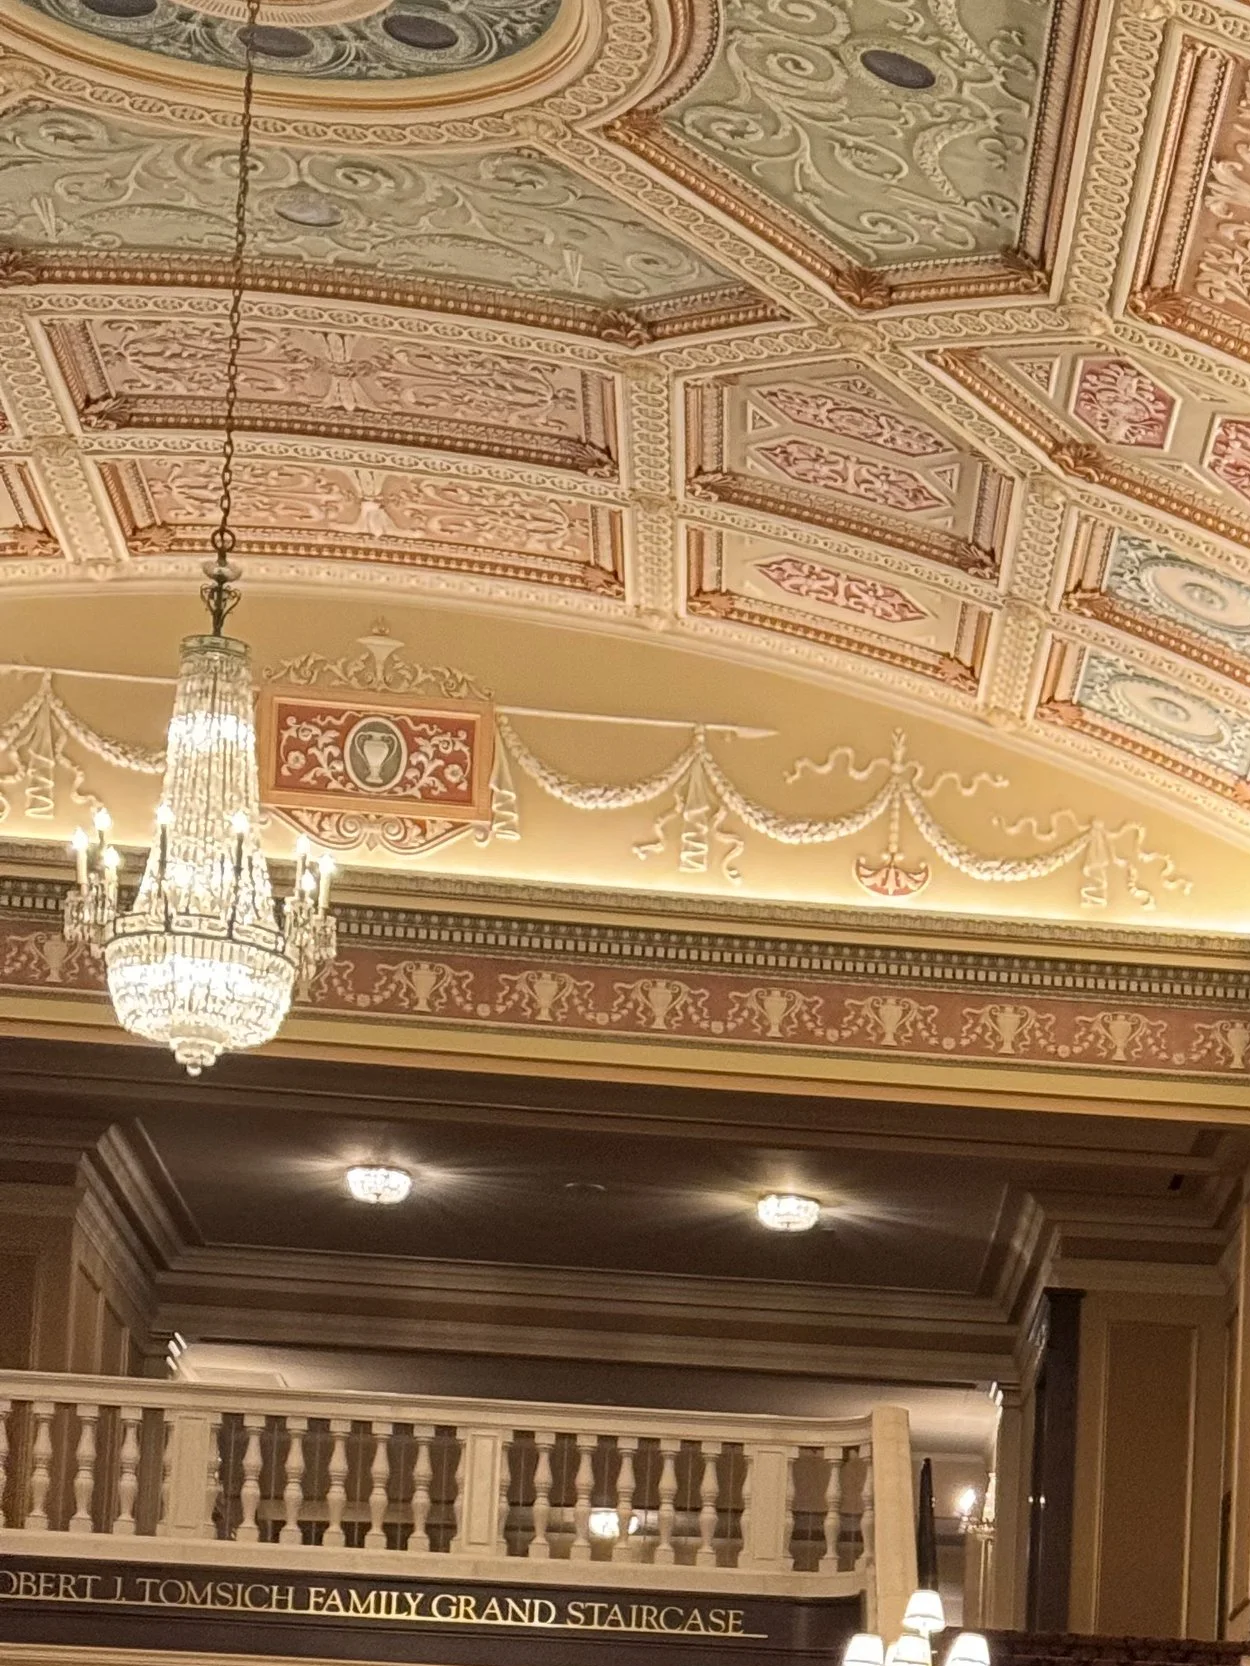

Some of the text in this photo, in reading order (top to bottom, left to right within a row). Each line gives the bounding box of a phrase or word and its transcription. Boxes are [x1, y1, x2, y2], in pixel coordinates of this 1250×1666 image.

[111, 1577, 126, 1603] J.
[137, 1578, 294, 1611] TOMSICH
[309, 1587, 424, 1617] FAMILY
[431, 1594, 556, 1624] GRAND
[566, 1601, 745, 1634] STAIRCASE
